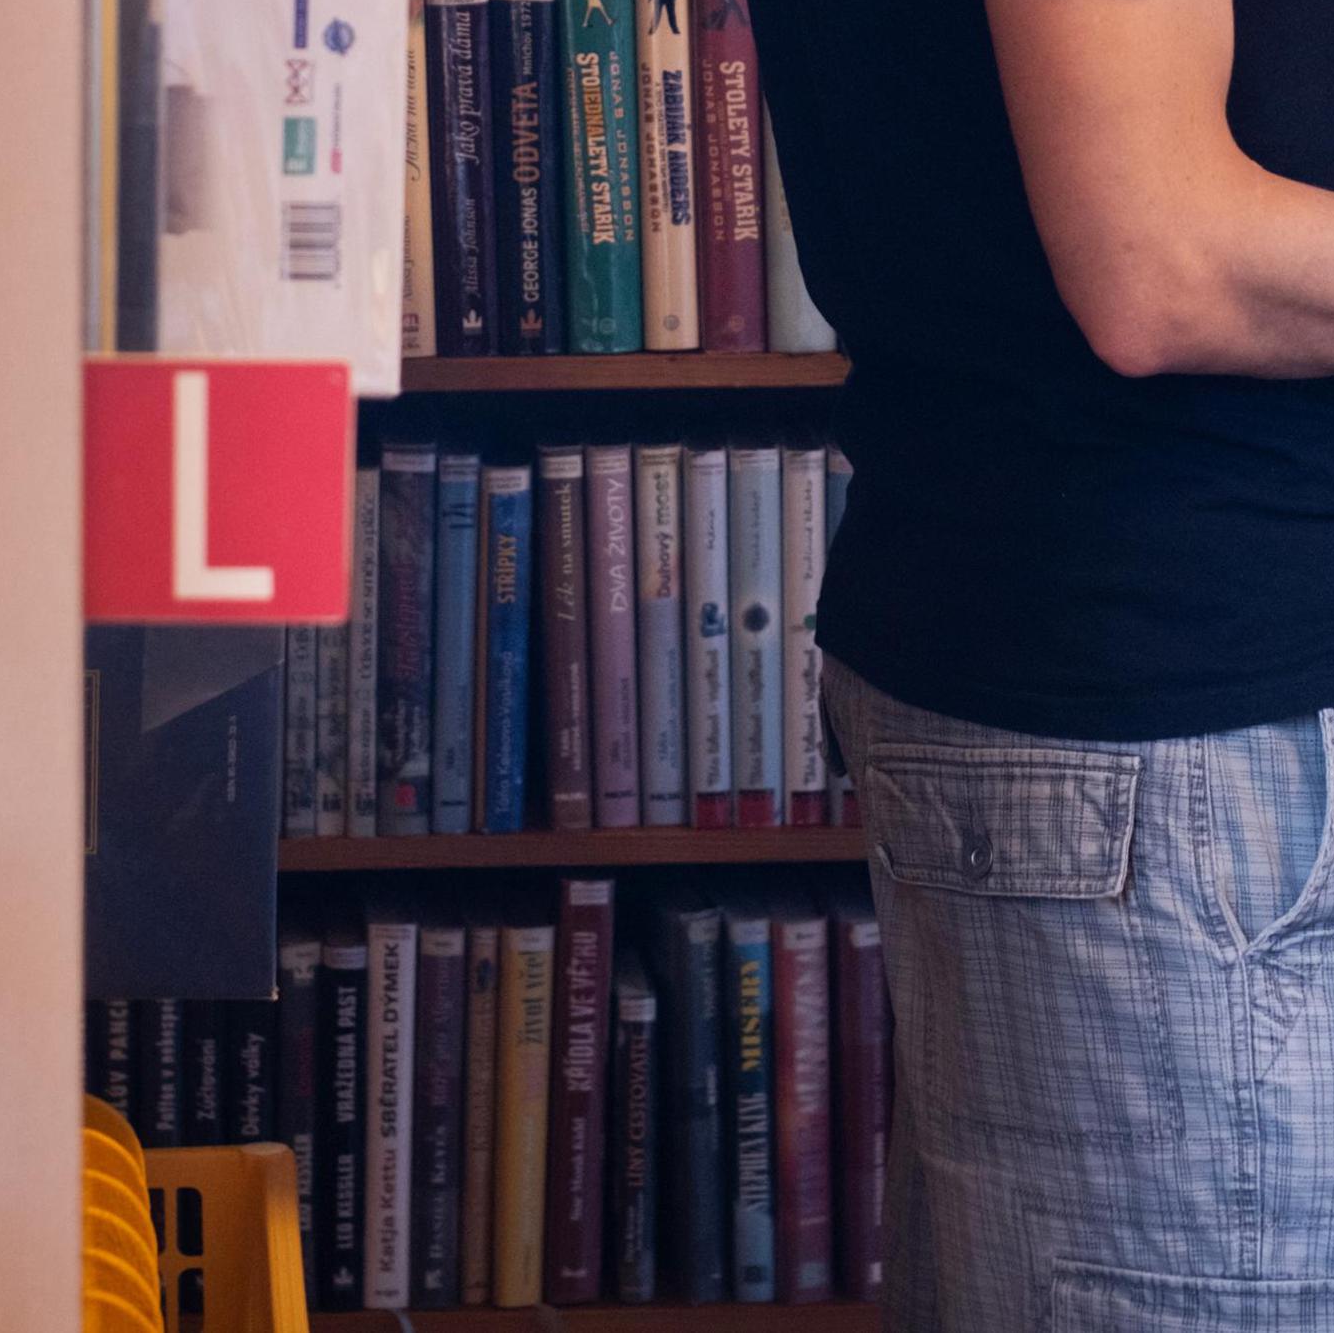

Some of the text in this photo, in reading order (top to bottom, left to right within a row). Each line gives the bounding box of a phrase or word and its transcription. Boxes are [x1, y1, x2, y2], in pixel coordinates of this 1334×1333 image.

[448, 10, 482, 299] Alissa Johnson Jako pravá dáma
[511, 0, 541, 303] GEORGE JONAS ODVETA Mnichov 1972
[609, 50, 637, 242] JONASSON JONAS
[640, 61, 662, 233] JONASSON JONAS
[666, 150, 692, 227] ANDERS
[702, 57, 726, 241] JONASSON JONAS
[717, 60, 762, 242] STAŘÍK STOLETÝ
[171, 369, 275, 601] L
[555, 482, 574, 550] smutek
[653, 471, 669, 527] most
[491, 534, 517, 605] STŘÍPKY
[558, 554, 573, 576] na
[604, 478, 628, 613] DVA ŽIVOTY
[240, 1033, 264, 1078] války
[336, 986, 358, 1029] PAST
[565, 1023, 596, 1093] KŘÍDLA
[568, 996, 596, 1019] VE
[195, 1039, 216, 1120] Zúčtování
[376, 942, 401, 1275] Katja Kettu SBĚRATEL DÝMEK
[737, 960, 769, 1214] STEPHEN KING MISERY
